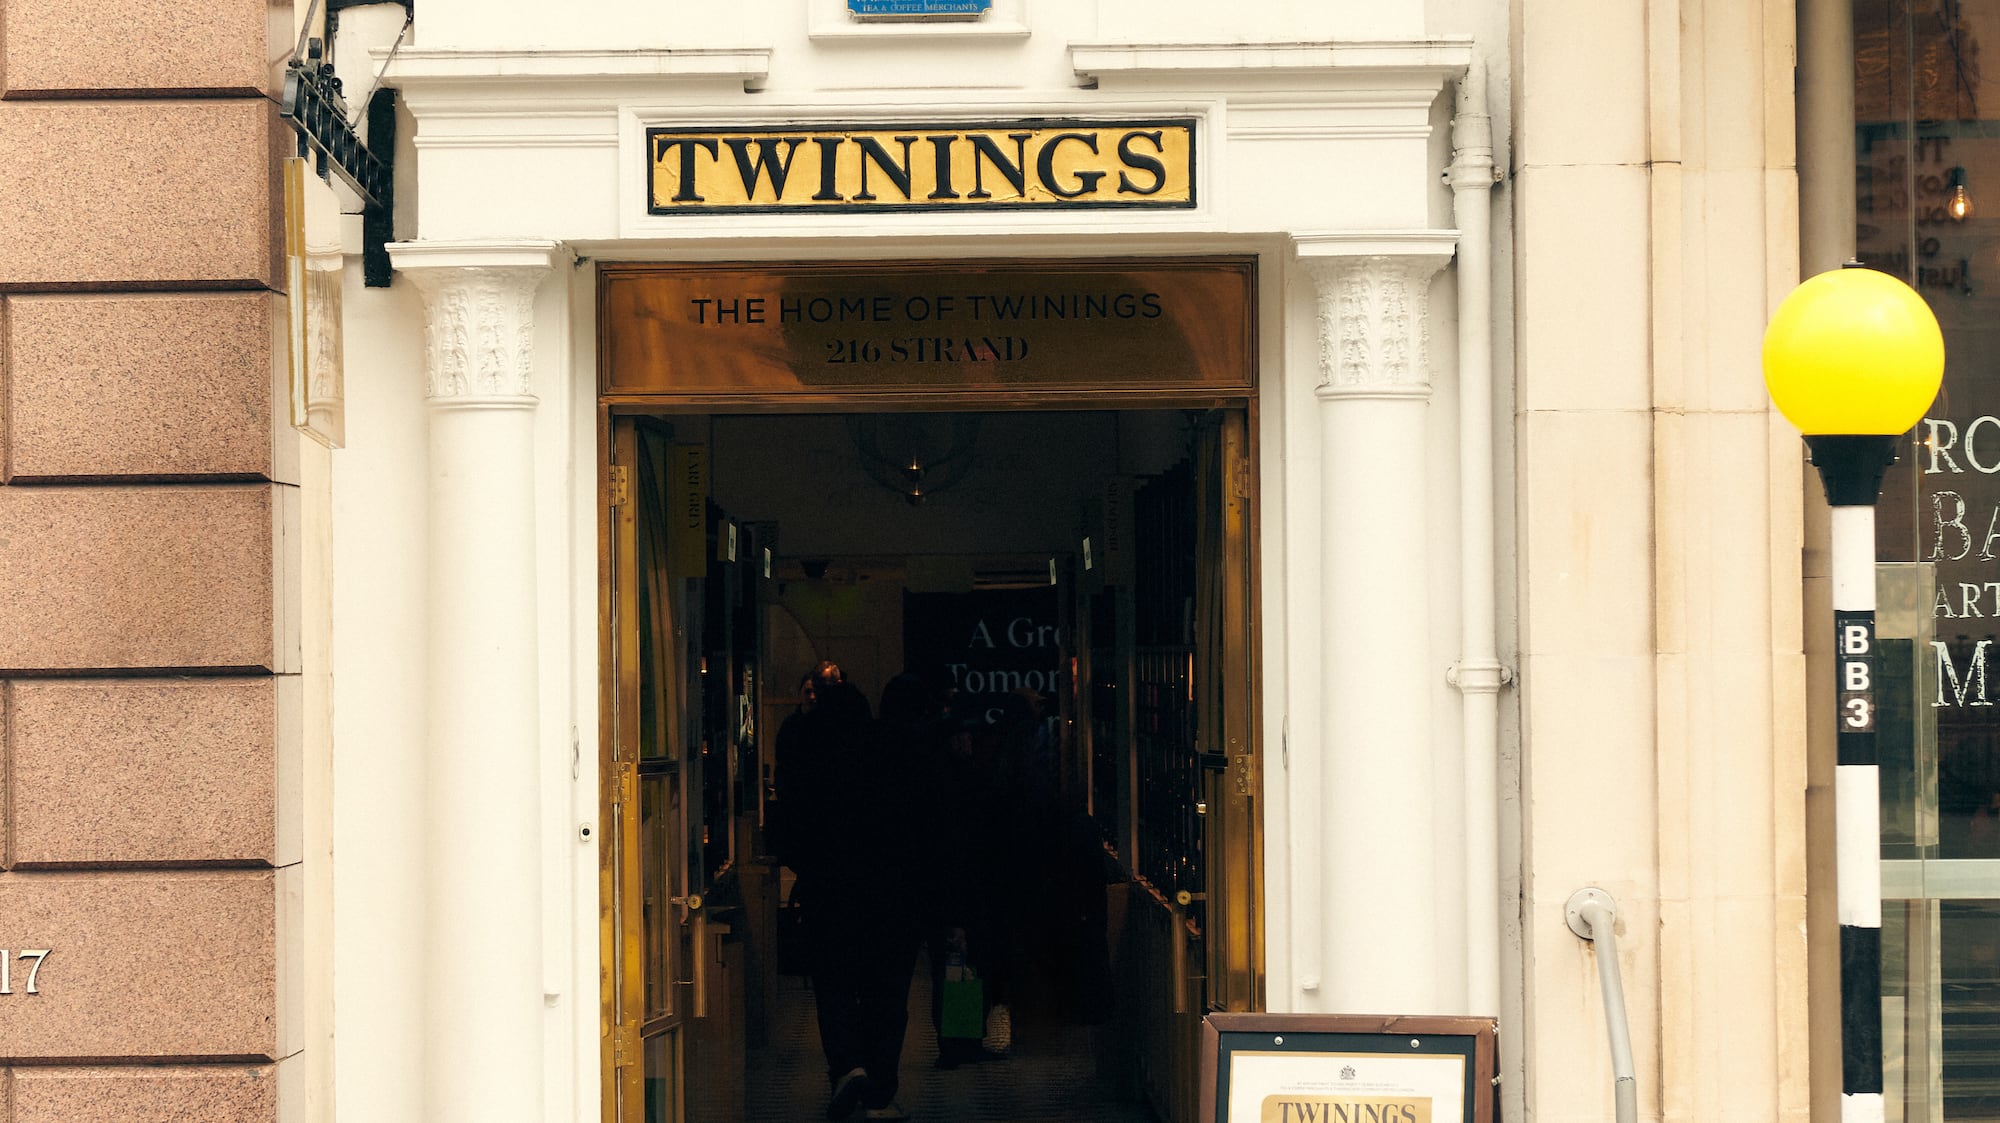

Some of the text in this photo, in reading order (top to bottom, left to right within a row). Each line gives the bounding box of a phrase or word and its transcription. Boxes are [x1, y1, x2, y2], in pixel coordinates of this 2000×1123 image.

[925, 3, 979, 11] MERCHANTS
[657, 130, 1167, 202] TWININGS
[691, 293, 1163, 324] THE HOME OF TWININGS
[826, 336, 1029, 363] 216 STRAND
[967, 618, 998, 648] A
[1278, 1102, 1416, 1123] TWININGS
